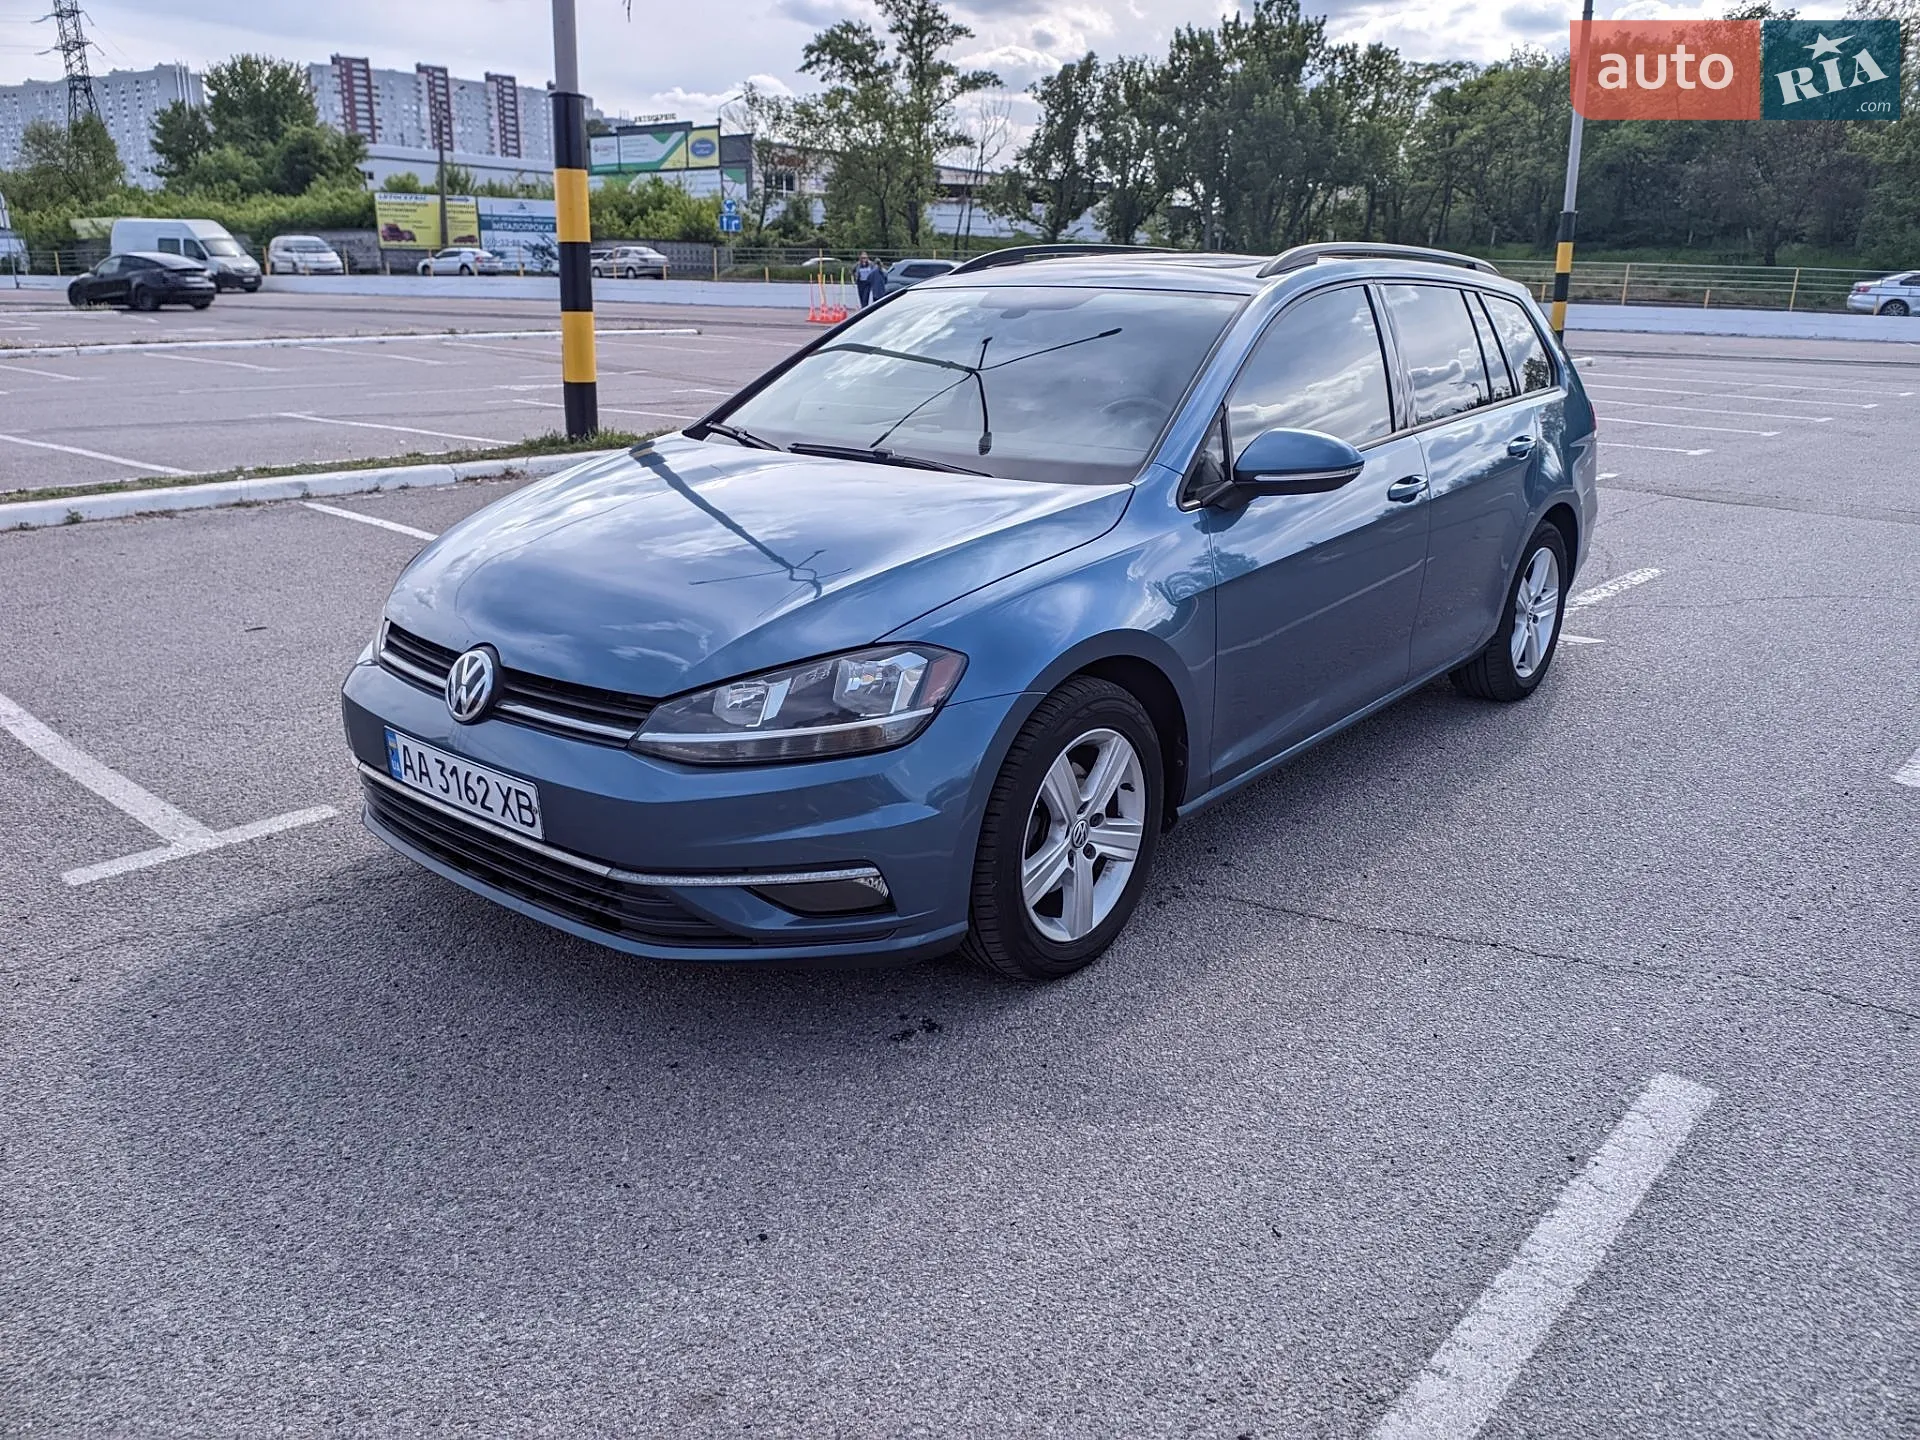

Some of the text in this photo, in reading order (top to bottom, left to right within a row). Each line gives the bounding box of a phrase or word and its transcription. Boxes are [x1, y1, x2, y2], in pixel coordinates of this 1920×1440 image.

[402, 744, 536, 828] AA 3162 XB
